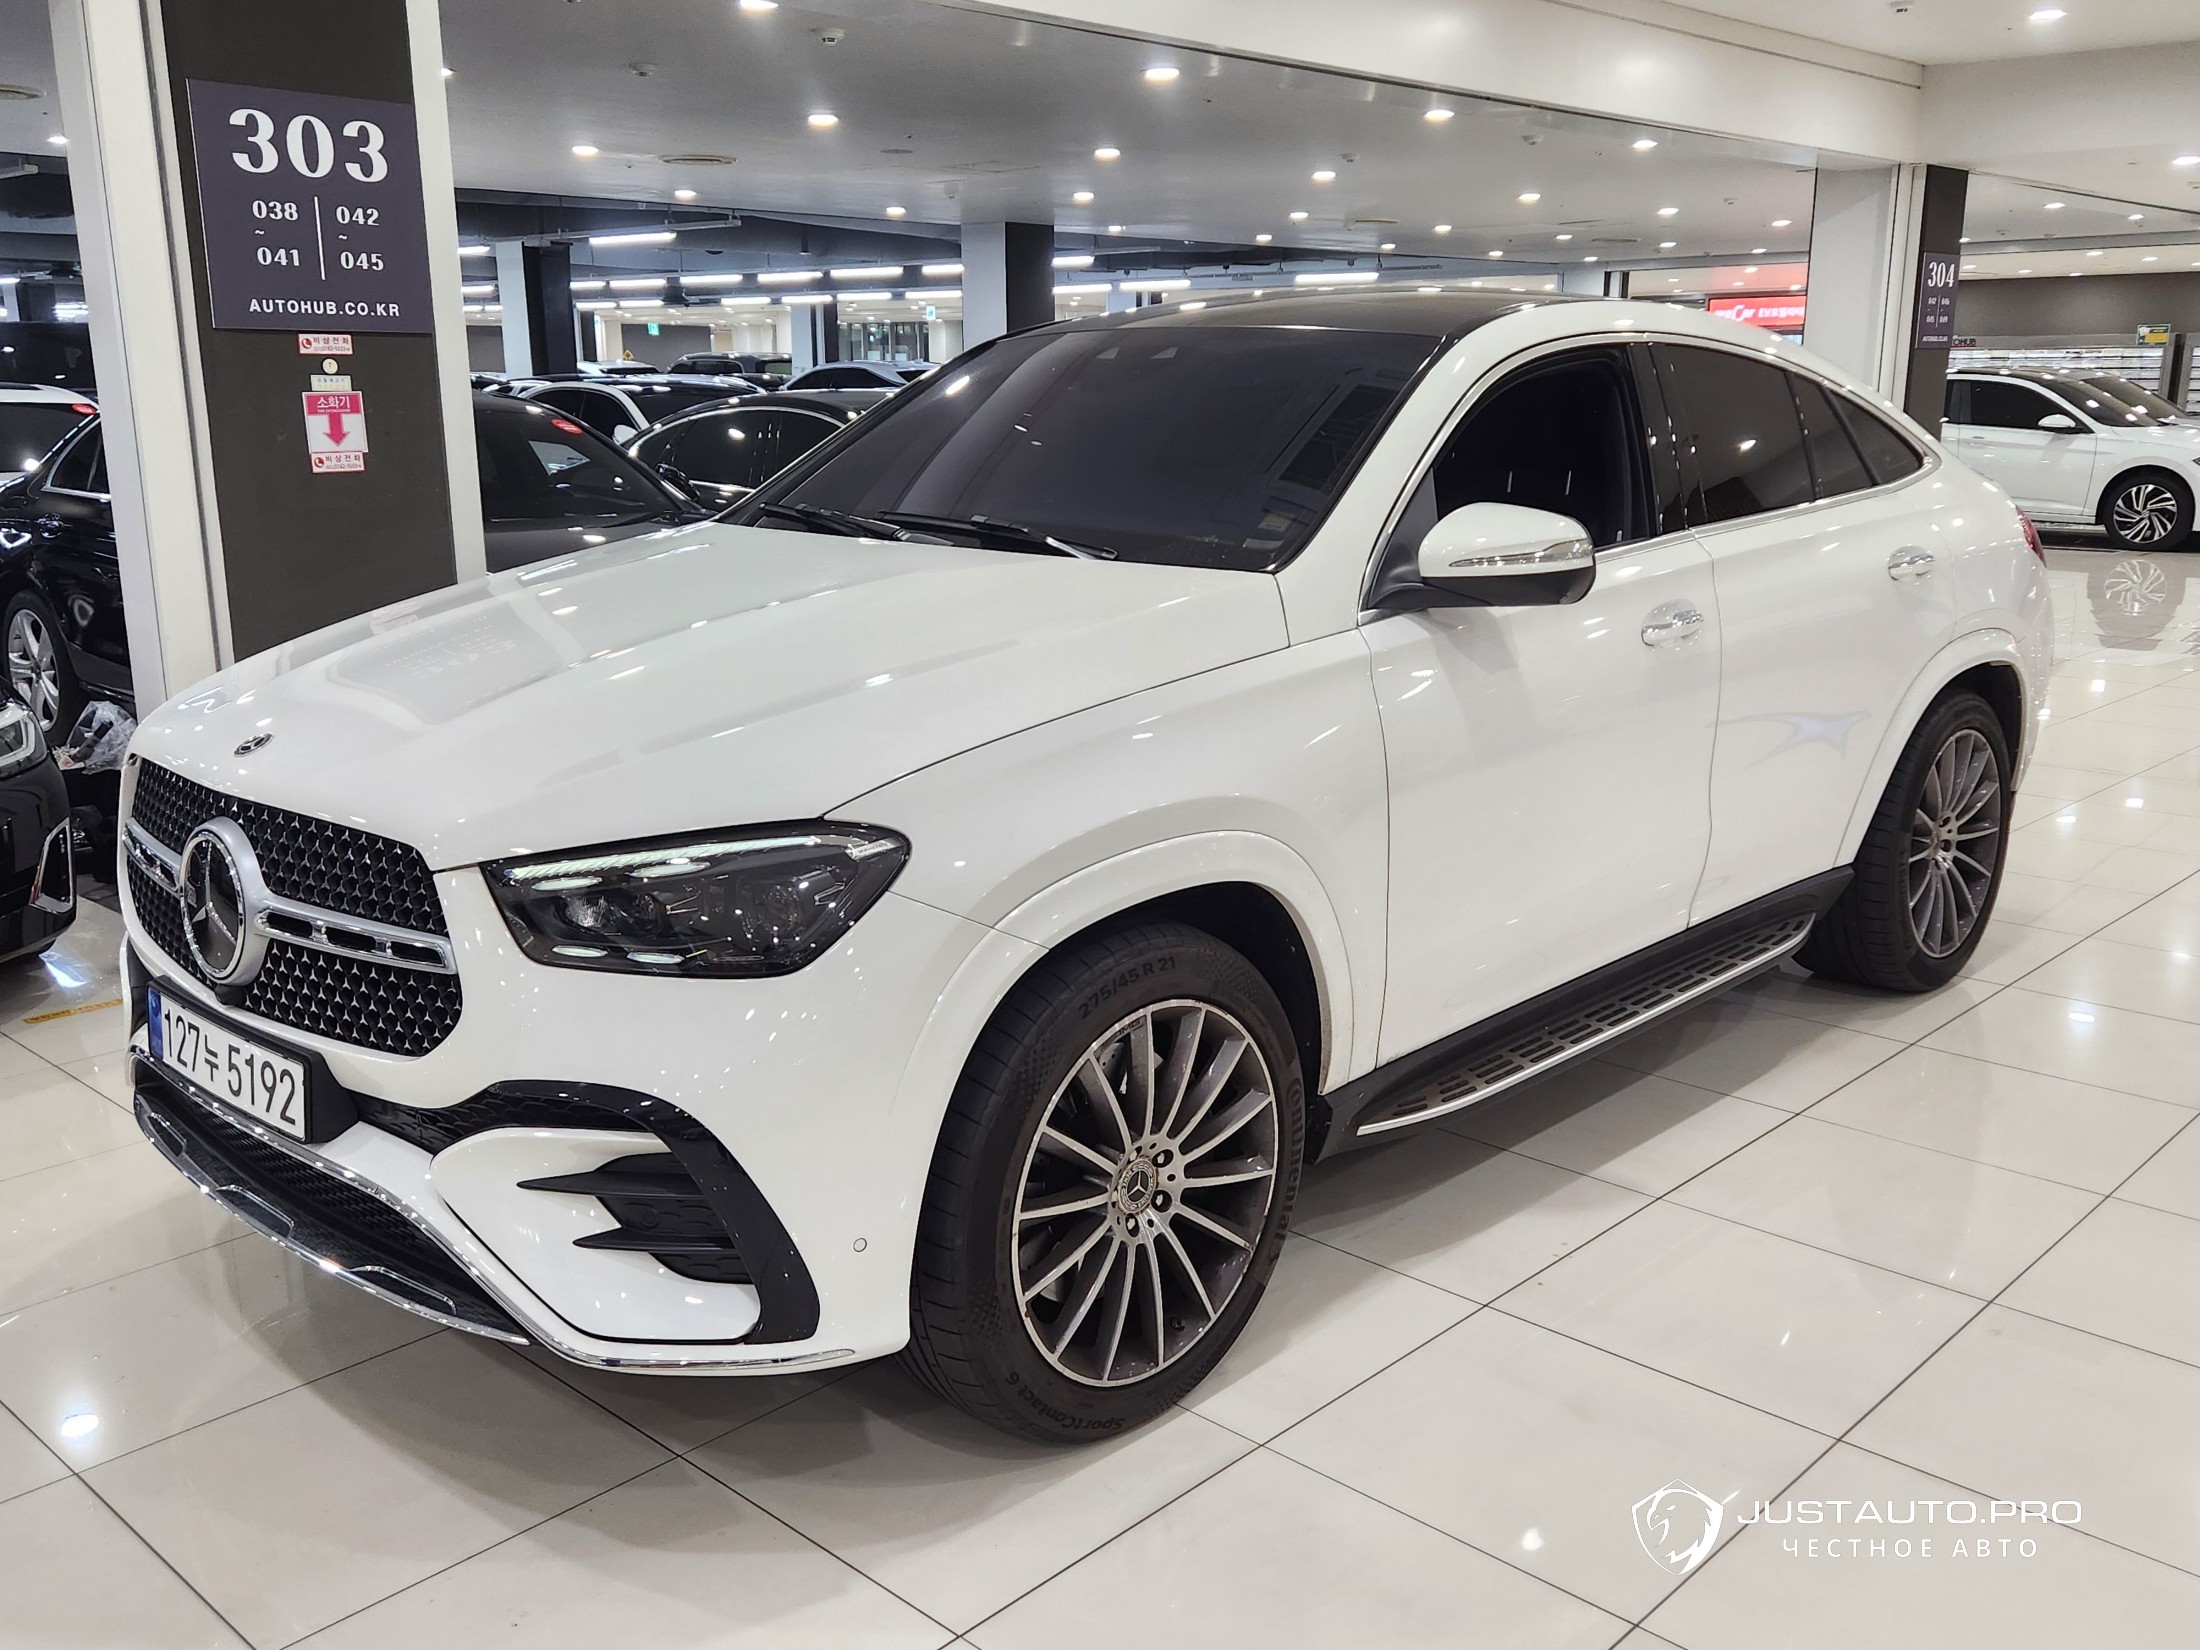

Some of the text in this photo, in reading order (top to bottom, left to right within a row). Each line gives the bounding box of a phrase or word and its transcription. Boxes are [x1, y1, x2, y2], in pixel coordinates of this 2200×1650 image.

[229, 108, 389, 183] 303
[252, 200, 299, 221] 038
[335, 206, 380, 226] 042
[256, 247, 300, 267] 041
[340, 251, 384, 271] 045
[1927, 261, 1955, 288] 304
[249, 298, 400, 317] AUTOHUB.CO.KR
[317, 395, 350, 409] 소화기
[1078, 956, 1176, 1020] 275/45 R 21
[164, 1008, 296, 1126] 127누 5192
[1004, 1370, 1126, 1431] SportContact 6
